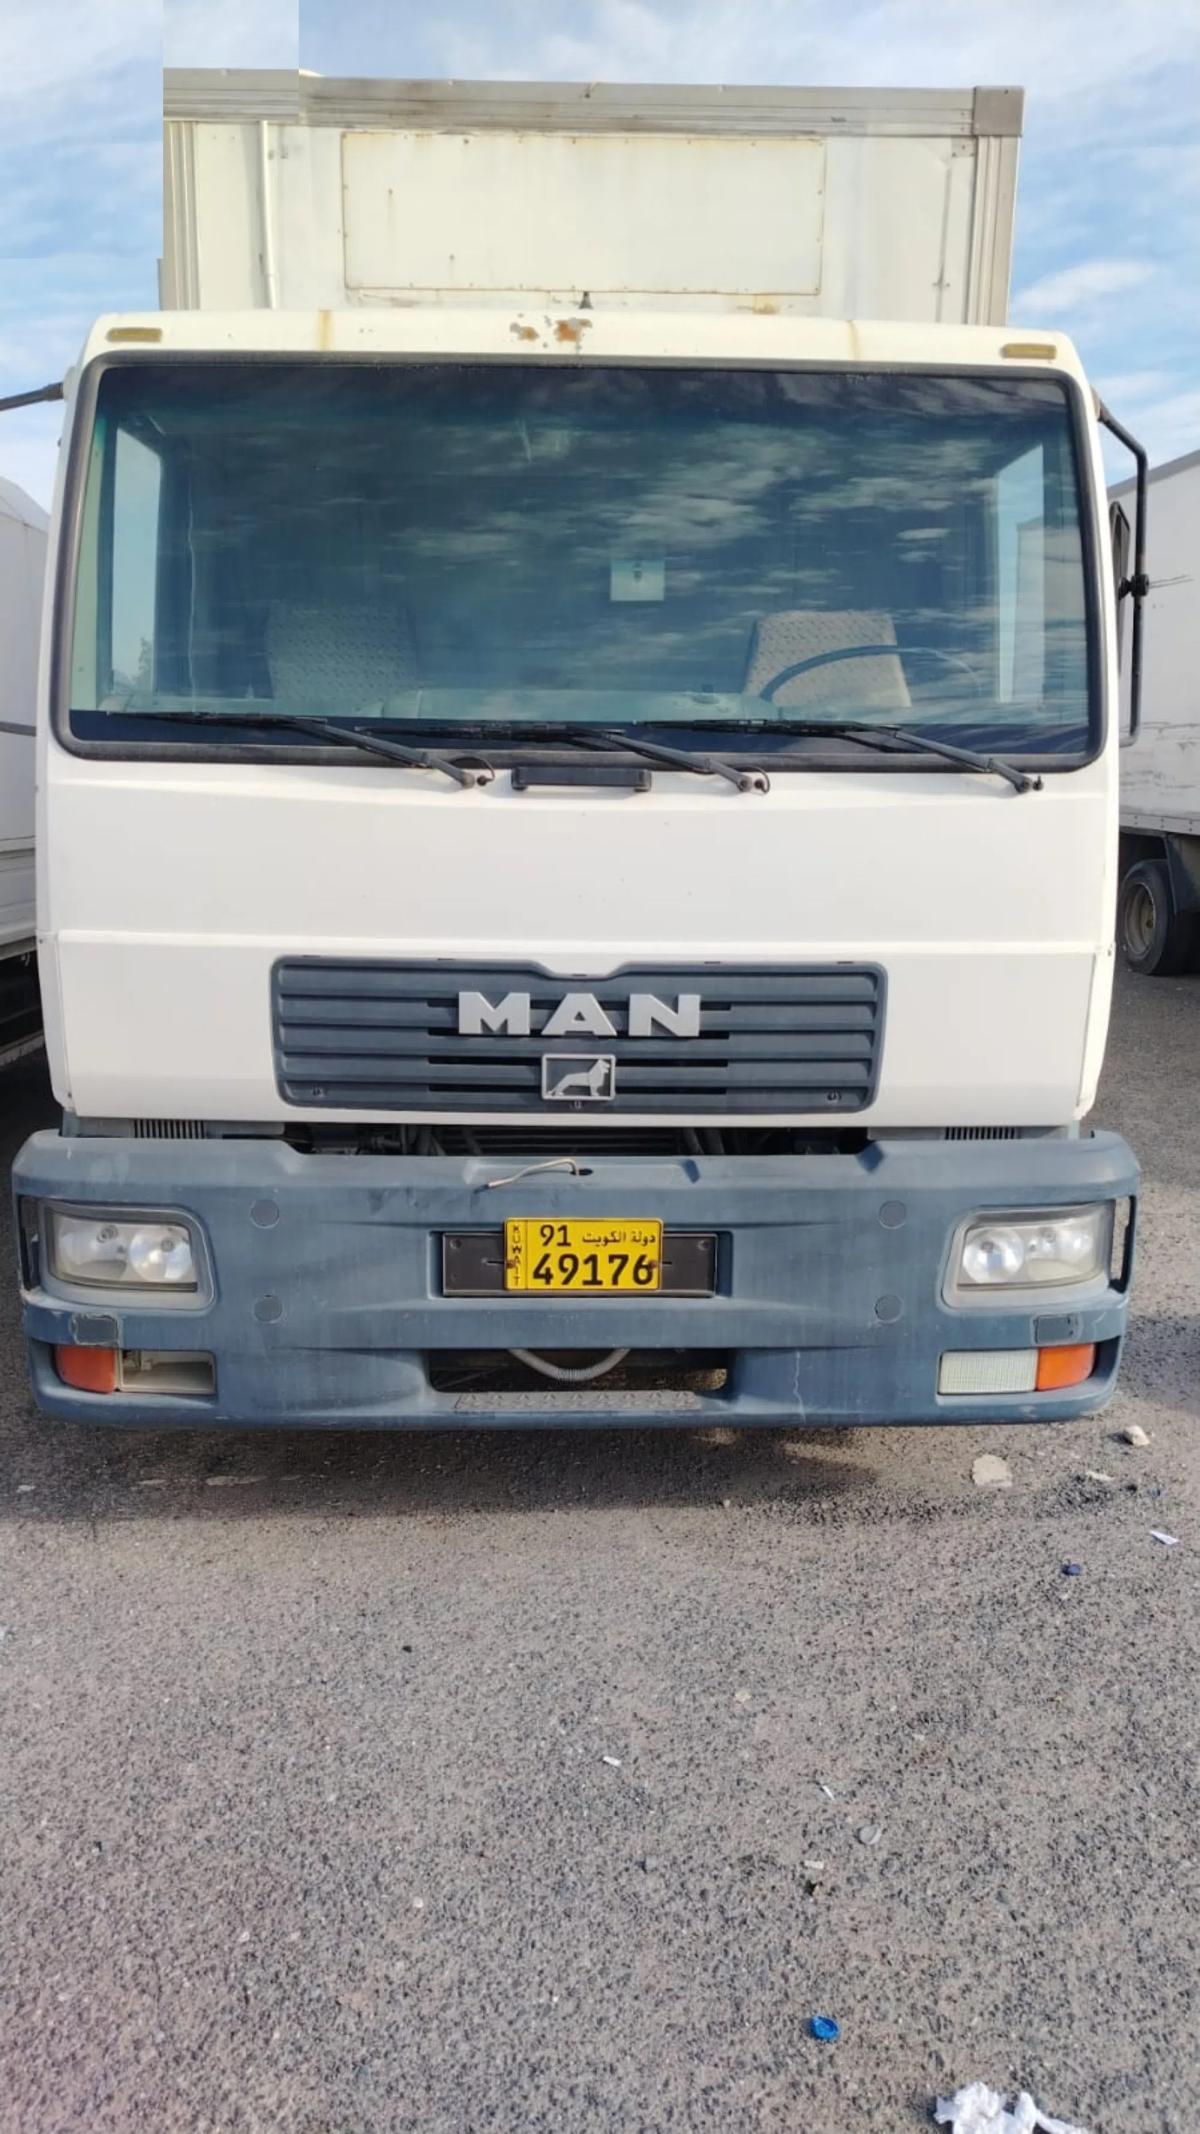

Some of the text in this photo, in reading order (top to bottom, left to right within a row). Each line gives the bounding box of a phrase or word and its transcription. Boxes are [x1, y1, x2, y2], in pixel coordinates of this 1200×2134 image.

[458, 991, 701, 1036] MAN
[540, 1224, 572, 1247] 91
[582, 1230, 656, 1247] دولة الكويت
[512, 1225, 522, 1286] KUWAIT
[532, 1253, 654, 1287] 49176
